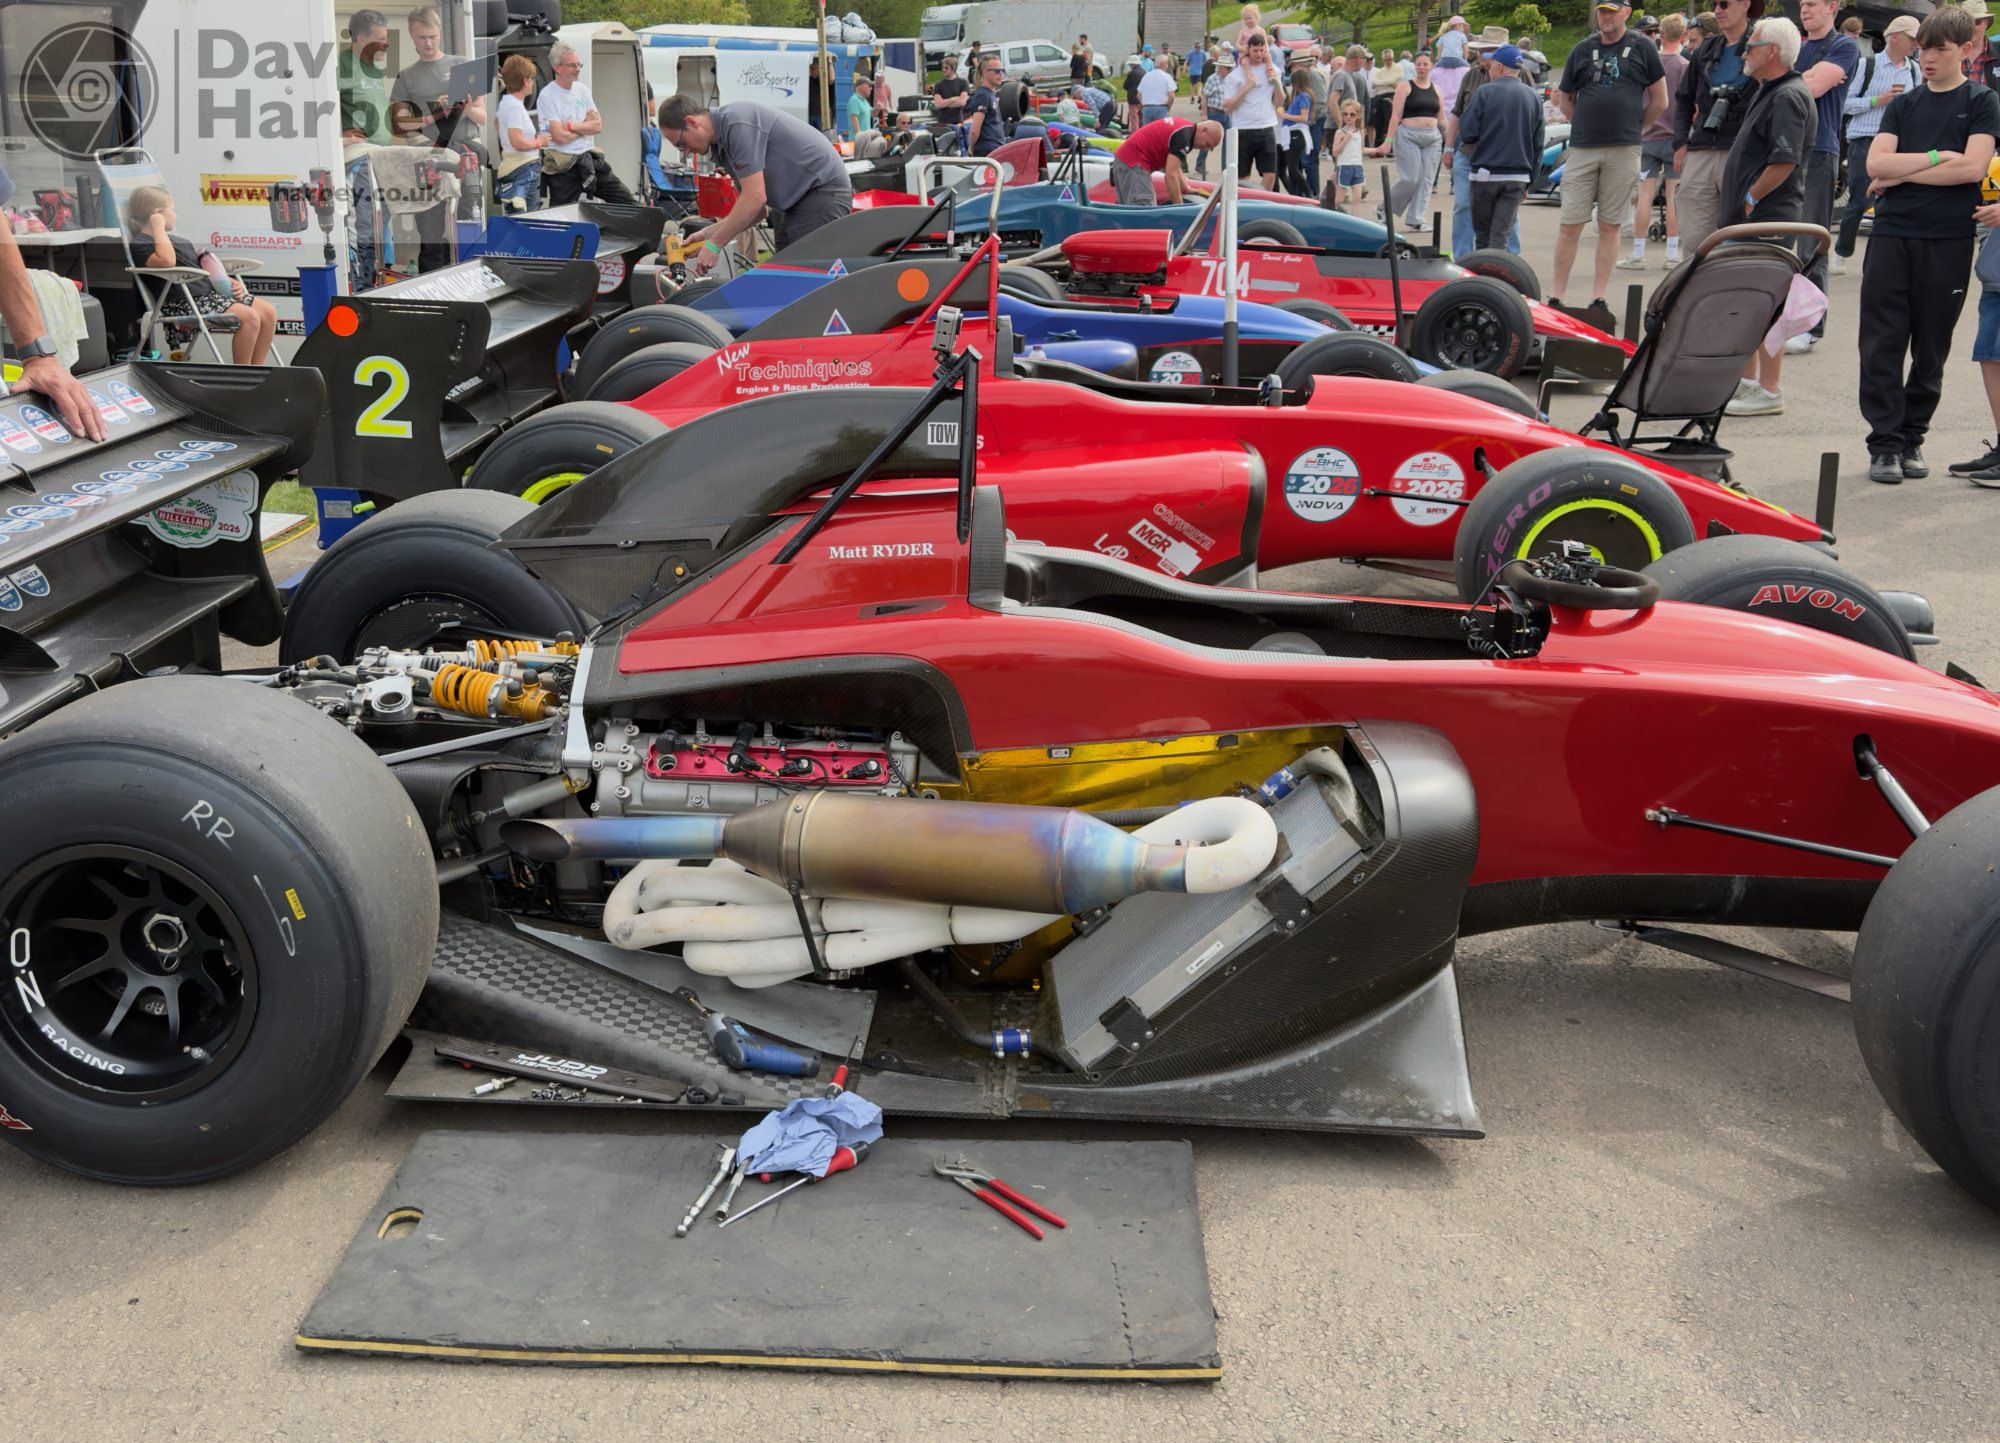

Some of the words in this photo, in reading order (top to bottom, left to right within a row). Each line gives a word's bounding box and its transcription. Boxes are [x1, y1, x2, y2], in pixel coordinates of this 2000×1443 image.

[223, 236, 302, 246] RACEPARTS
[598, 261, 624, 276] 026
[1201, 260, 1250, 297] 704
[716, 343, 750, 376] New
[1497, 332, 1520, 378] AVON
[735, 359, 873, 382] Techniques
[1160, 372, 1202, 386] 2026
[353, 355, 413, 439] 2
[736, 385, 769, 395] Engine
[783, 384, 808, 392] Race
[929, 423, 957, 444] TOW
[1316, 458, 1347, 467] BHC
[1422, 463, 1453, 472] BHC
[1299, 475, 1359, 495] 2026
[1405, 479, 1465, 499] 2026
[173, 507, 196, 516] MIDLAND
[1302, 500, 1344, 510] NOVA
[1426, 507, 1448, 515] BMTR
[158, 510, 212, 527] HILLCLIMB
[218, 521, 240, 534] 2026
[1153, 503, 1216, 551] COSWORTH
[1135, 524, 1172, 554] MGR
[1486, 480, 1552, 583] ZERO
[829, 546, 868, 559] Matt
[871, 542, 935, 558] RYDER
[15, 570, 39, 584] WINNER
[1747, 584, 1867, 622] AVON
[180, 799, 234, 853] RR
[40, 1023, 126, 1076] RACING
[517, 1053, 609, 1075] JUDD
